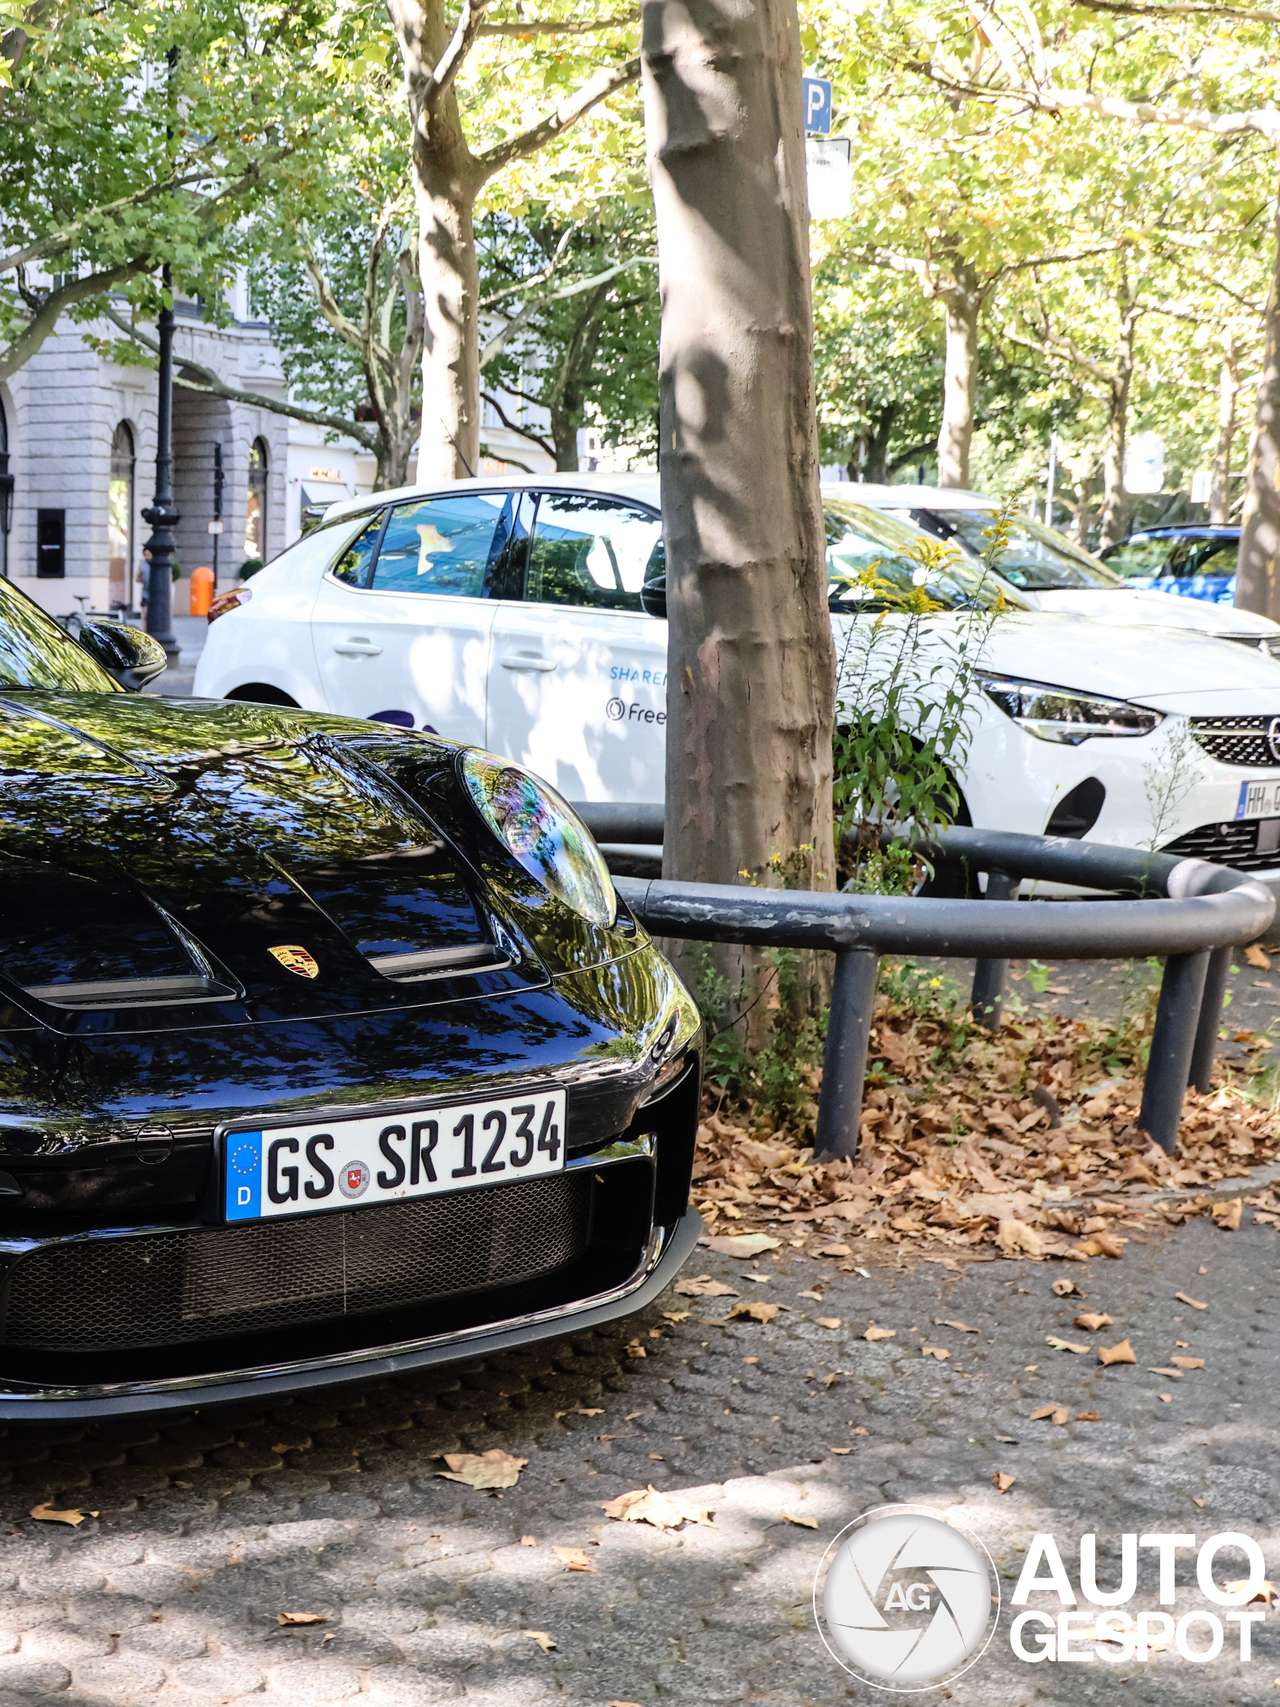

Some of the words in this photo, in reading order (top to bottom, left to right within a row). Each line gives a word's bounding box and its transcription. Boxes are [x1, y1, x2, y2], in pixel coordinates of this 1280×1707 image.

[808, 84, 825, 125] P
[1247, 787, 1267, 814] HH
[267, 1133, 335, 1205] GS
[376, 1118, 439, 1190] SR
[451, 1100, 562, 1179] 1234
[237, 1186, 251, 1206] D
